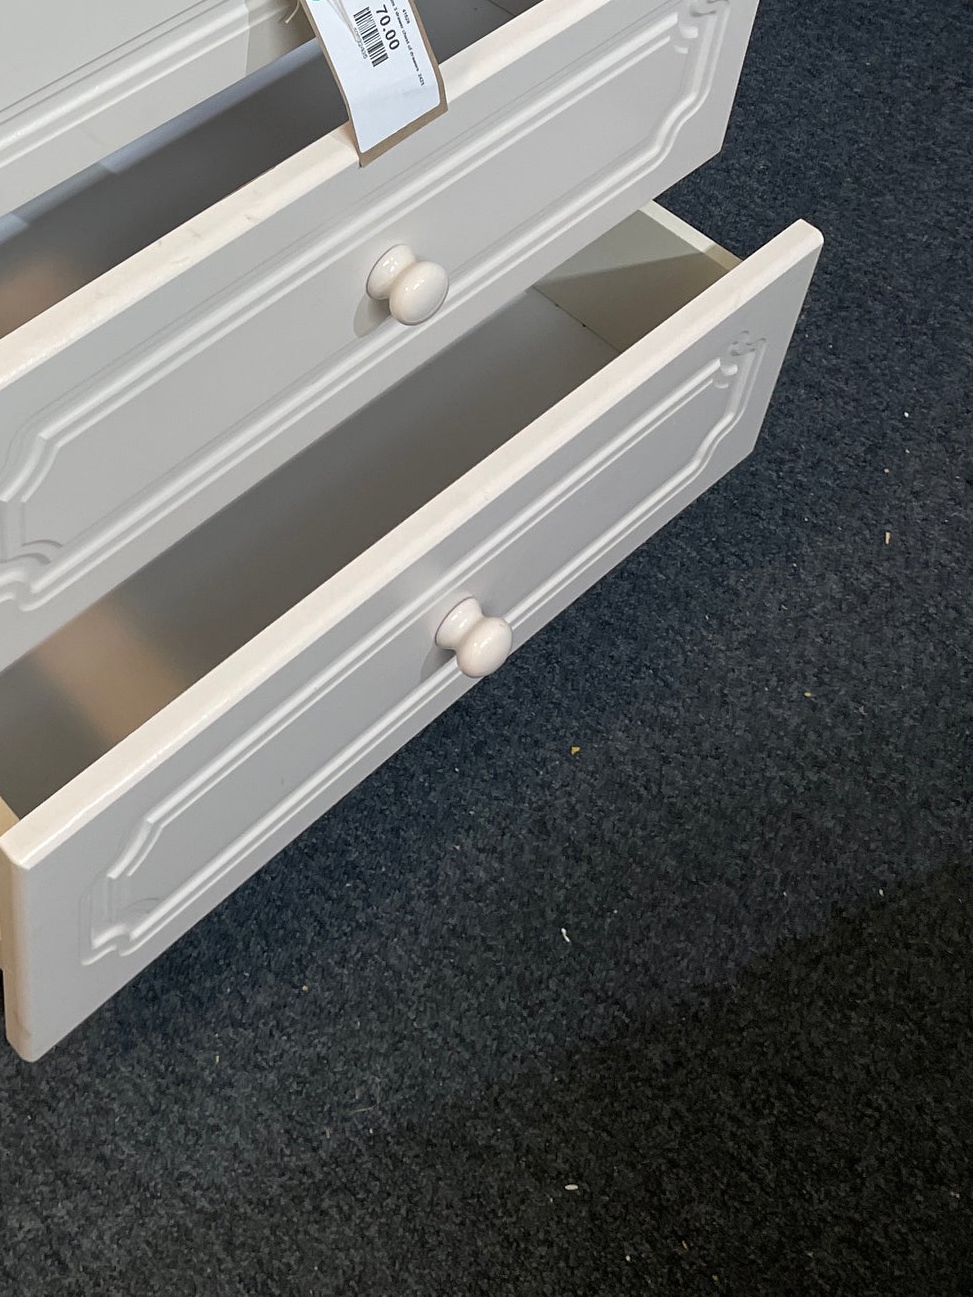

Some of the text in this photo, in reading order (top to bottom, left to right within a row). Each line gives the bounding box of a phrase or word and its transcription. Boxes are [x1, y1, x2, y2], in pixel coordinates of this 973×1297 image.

[376, 4, 400, 50] 70.00
[395, 11, 404, 29] drawer
[402, 30, 410, 44] chest
